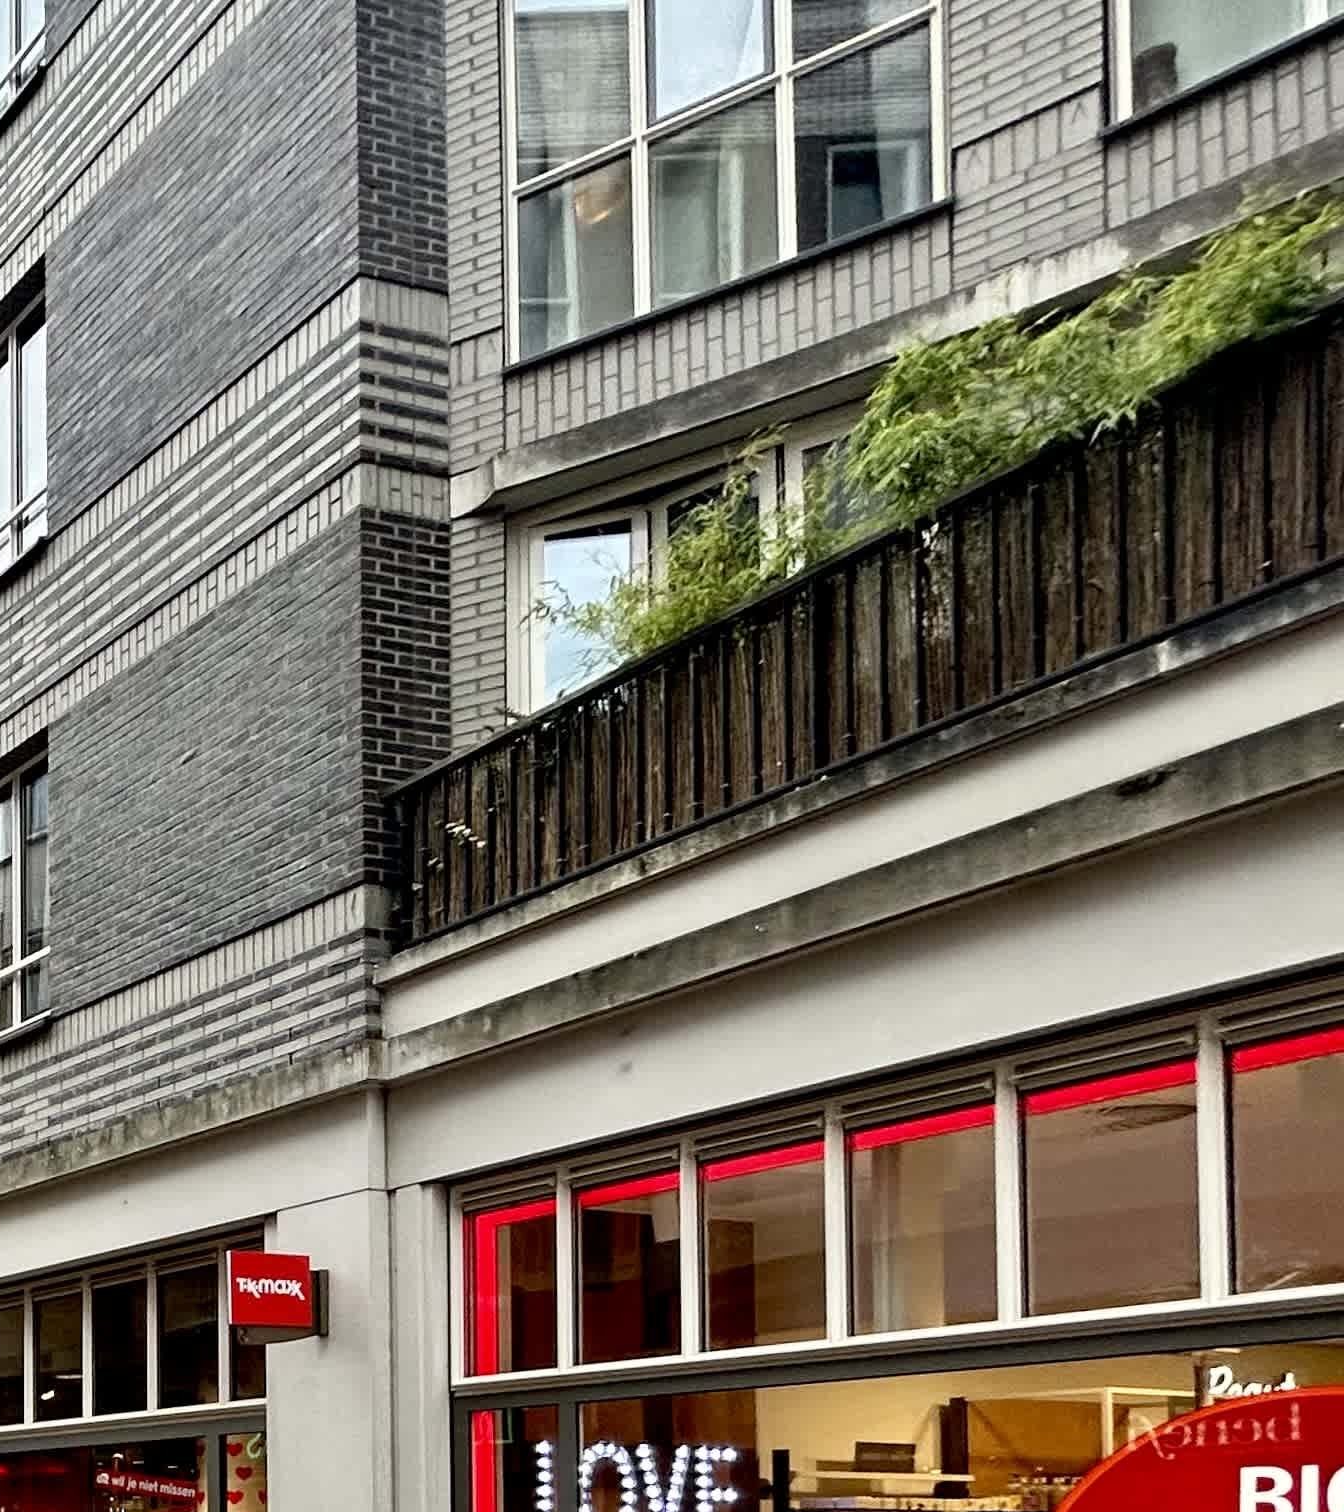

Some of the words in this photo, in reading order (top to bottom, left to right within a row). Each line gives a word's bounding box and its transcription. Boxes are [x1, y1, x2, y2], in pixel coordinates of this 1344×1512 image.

[126, 1477, 137, 1491] je
[139, 1480, 158, 1492] niet
[159, 1483, 195, 1497] missen
